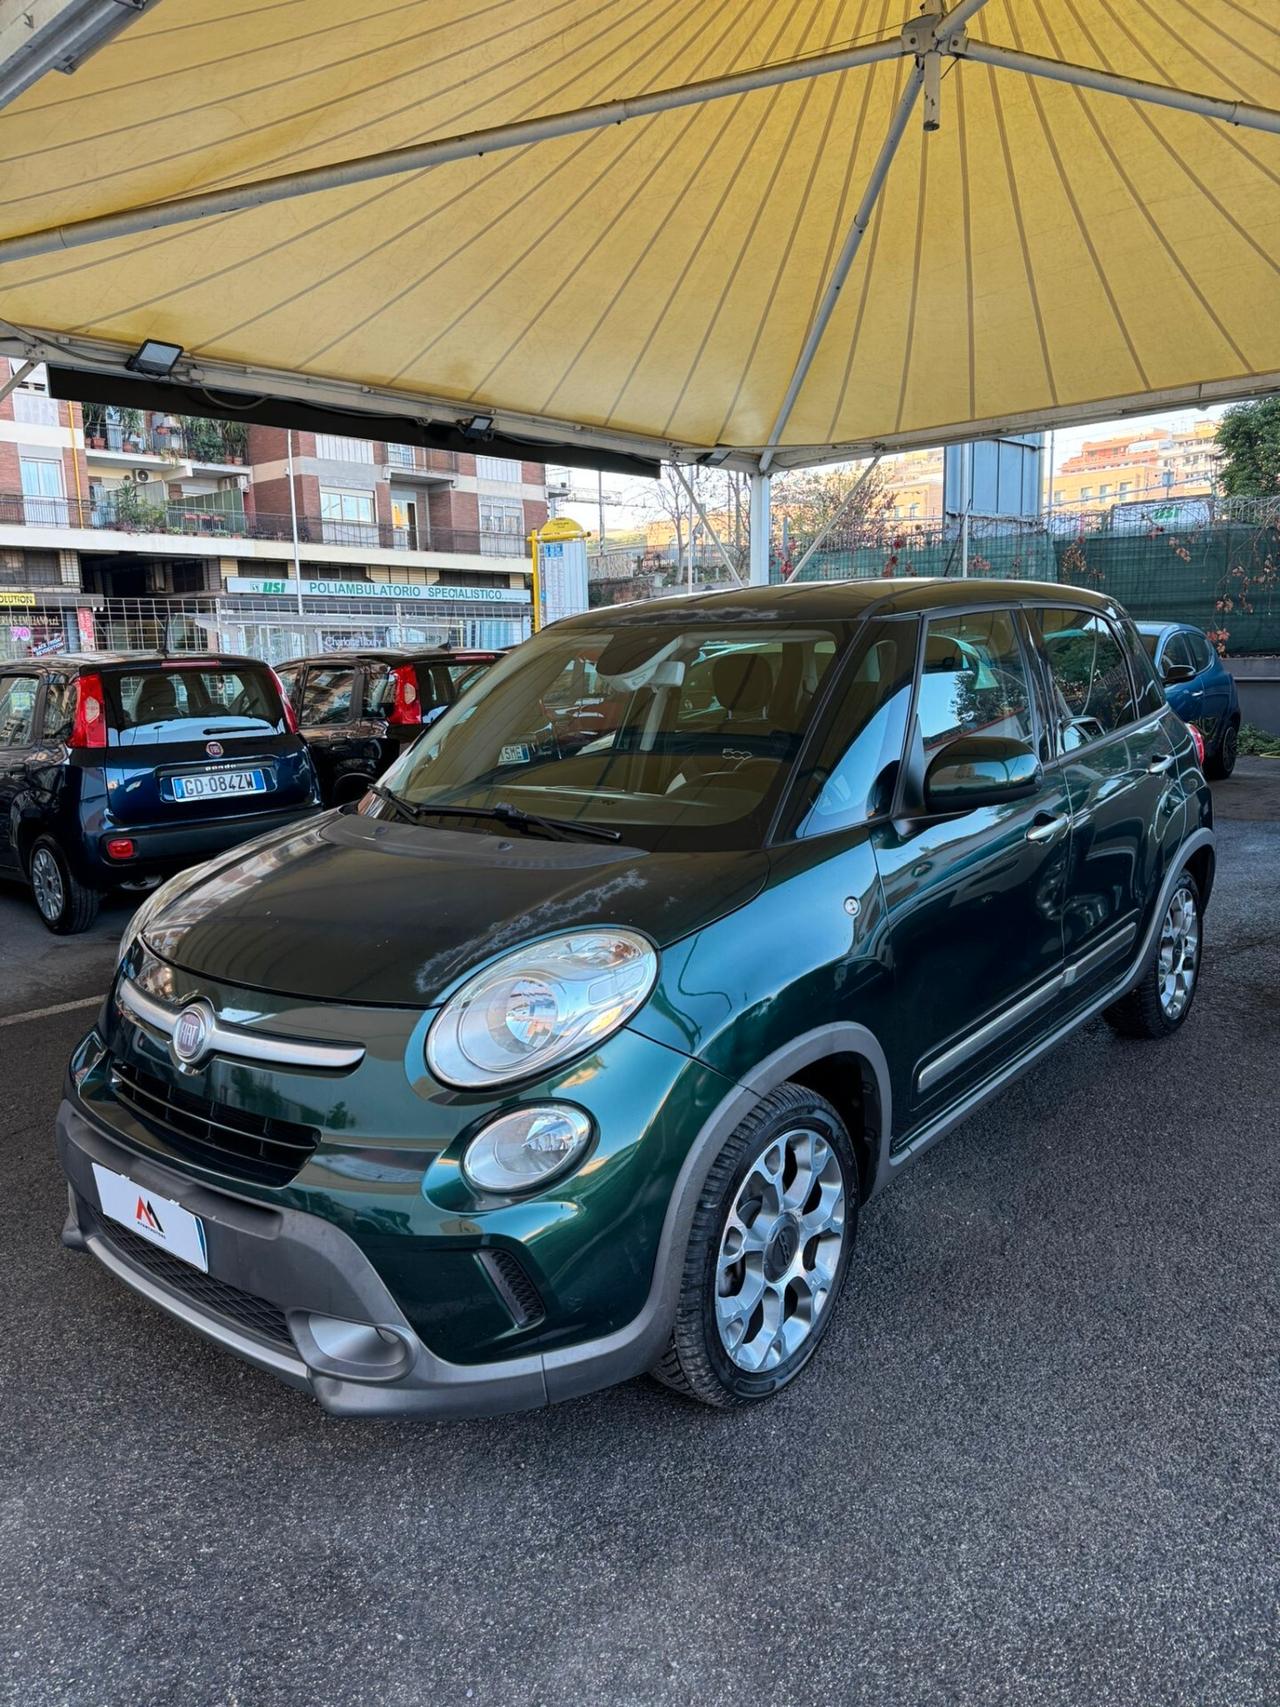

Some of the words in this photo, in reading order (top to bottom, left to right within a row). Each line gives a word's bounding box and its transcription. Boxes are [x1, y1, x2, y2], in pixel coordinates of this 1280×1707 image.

[263, 581, 286, 593] USI
[309, 581, 421, 597] POLIAMBULATORIO
[428, 586, 502, 600] SPECIALISTICO
